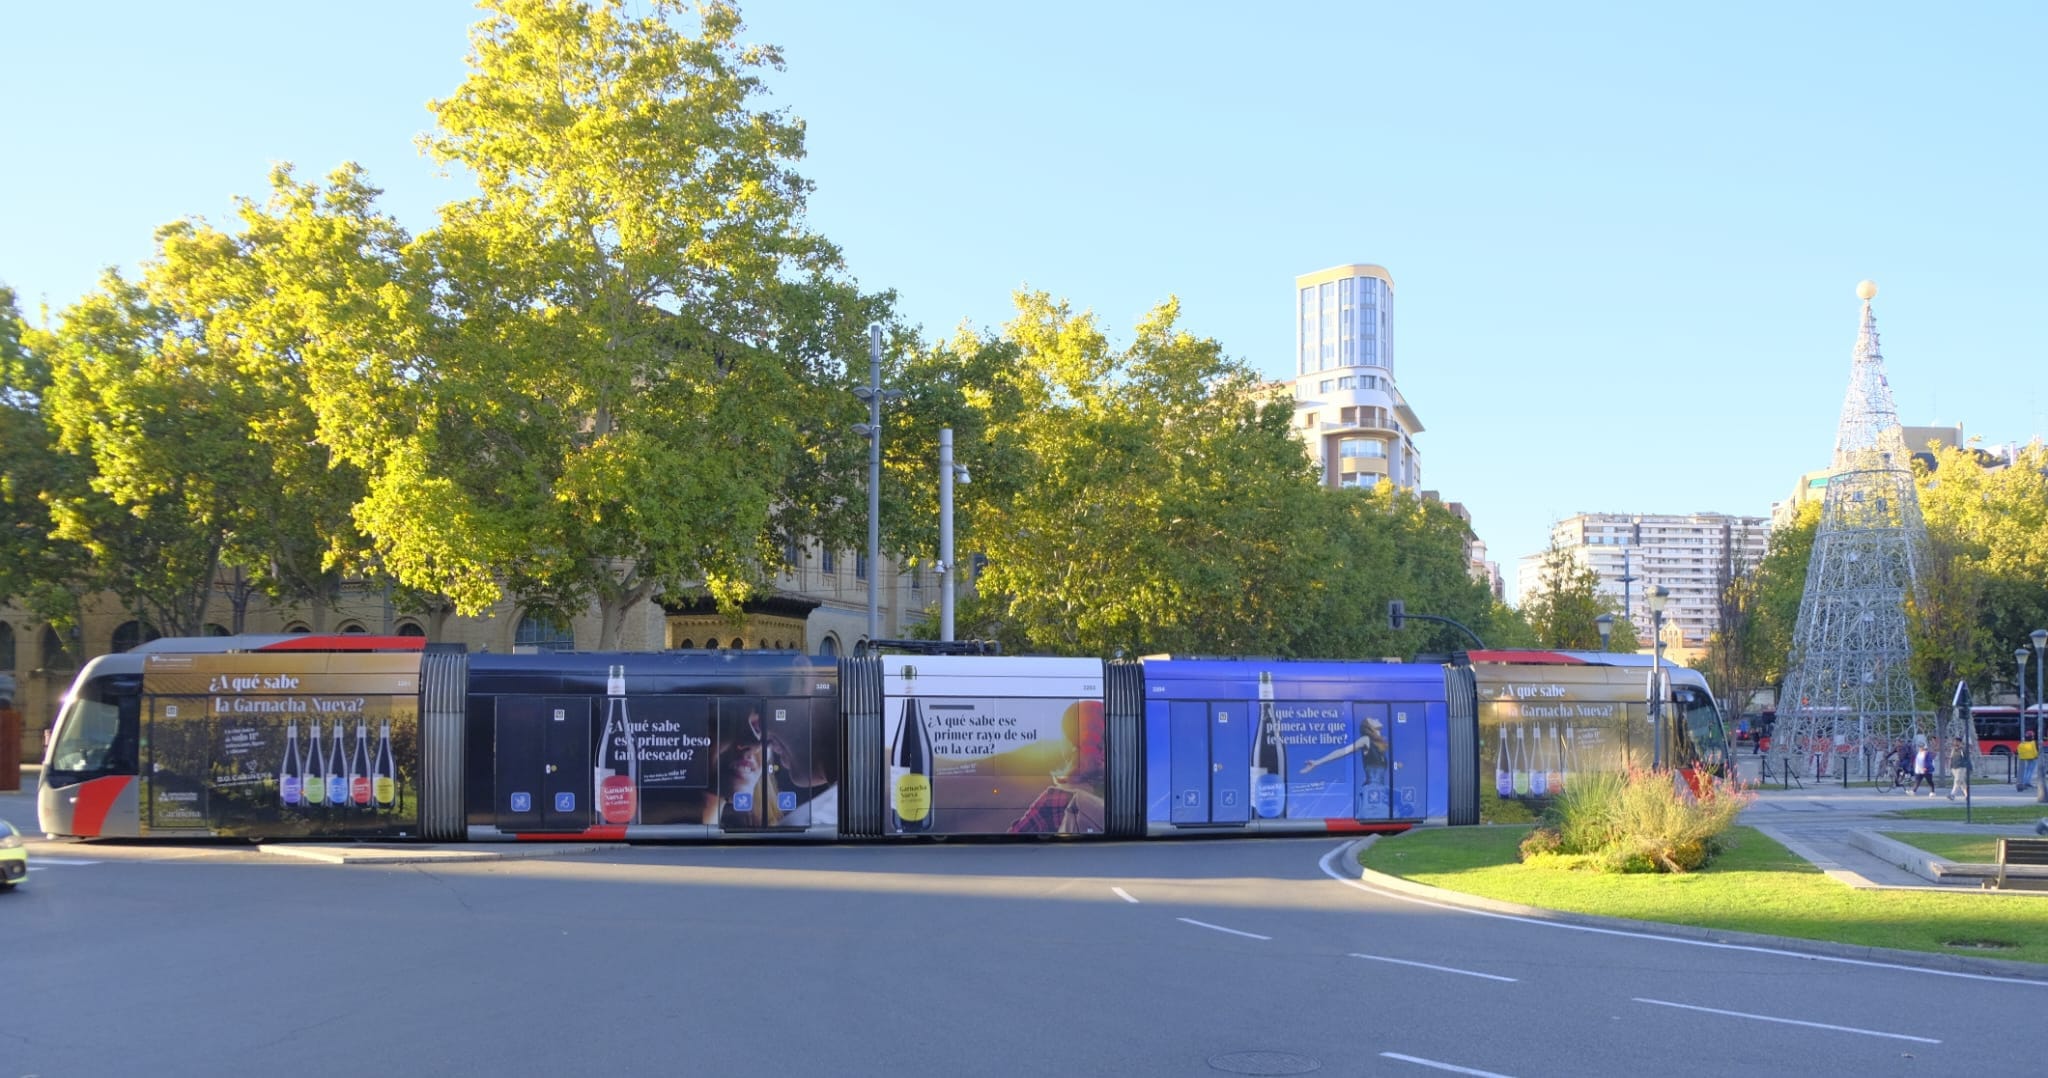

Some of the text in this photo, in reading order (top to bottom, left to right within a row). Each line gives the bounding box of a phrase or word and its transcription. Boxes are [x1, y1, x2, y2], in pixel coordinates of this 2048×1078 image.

[209, 674, 299, 692] ¿A qué sabe
[1517, 684, 1537, 699] qué
[1540, 684, 1566, 697] sabe
[215, 697, 365, 713] la Garnacha Nueva?
[1521, 703, 1573, 717] Garnacha
[1576, 704, 1613, 717] Nueva?
[1276, 706, 1294, 720] qué
[1296, 707, 1319, 718] sabe
[1322, 709, 1338, 718] esa
[628, 719, 649, 734] qué
[652, 720, 680, 732] sabe
[928, 714, 1016, 728] ¿A qué sabe ese
[1266, 720, 1346, 733] primera vez que
[638, 734, 680, 748] primer
[682, 734, 711, 746] beso
[934, 729, 1037, 742] primer rayo de sol
[1266, 733, 1348, 744] te sentiste libre?
[614, 748, 694, 760] tan deseado?
[934, 743, 995, 754] en la cara?
